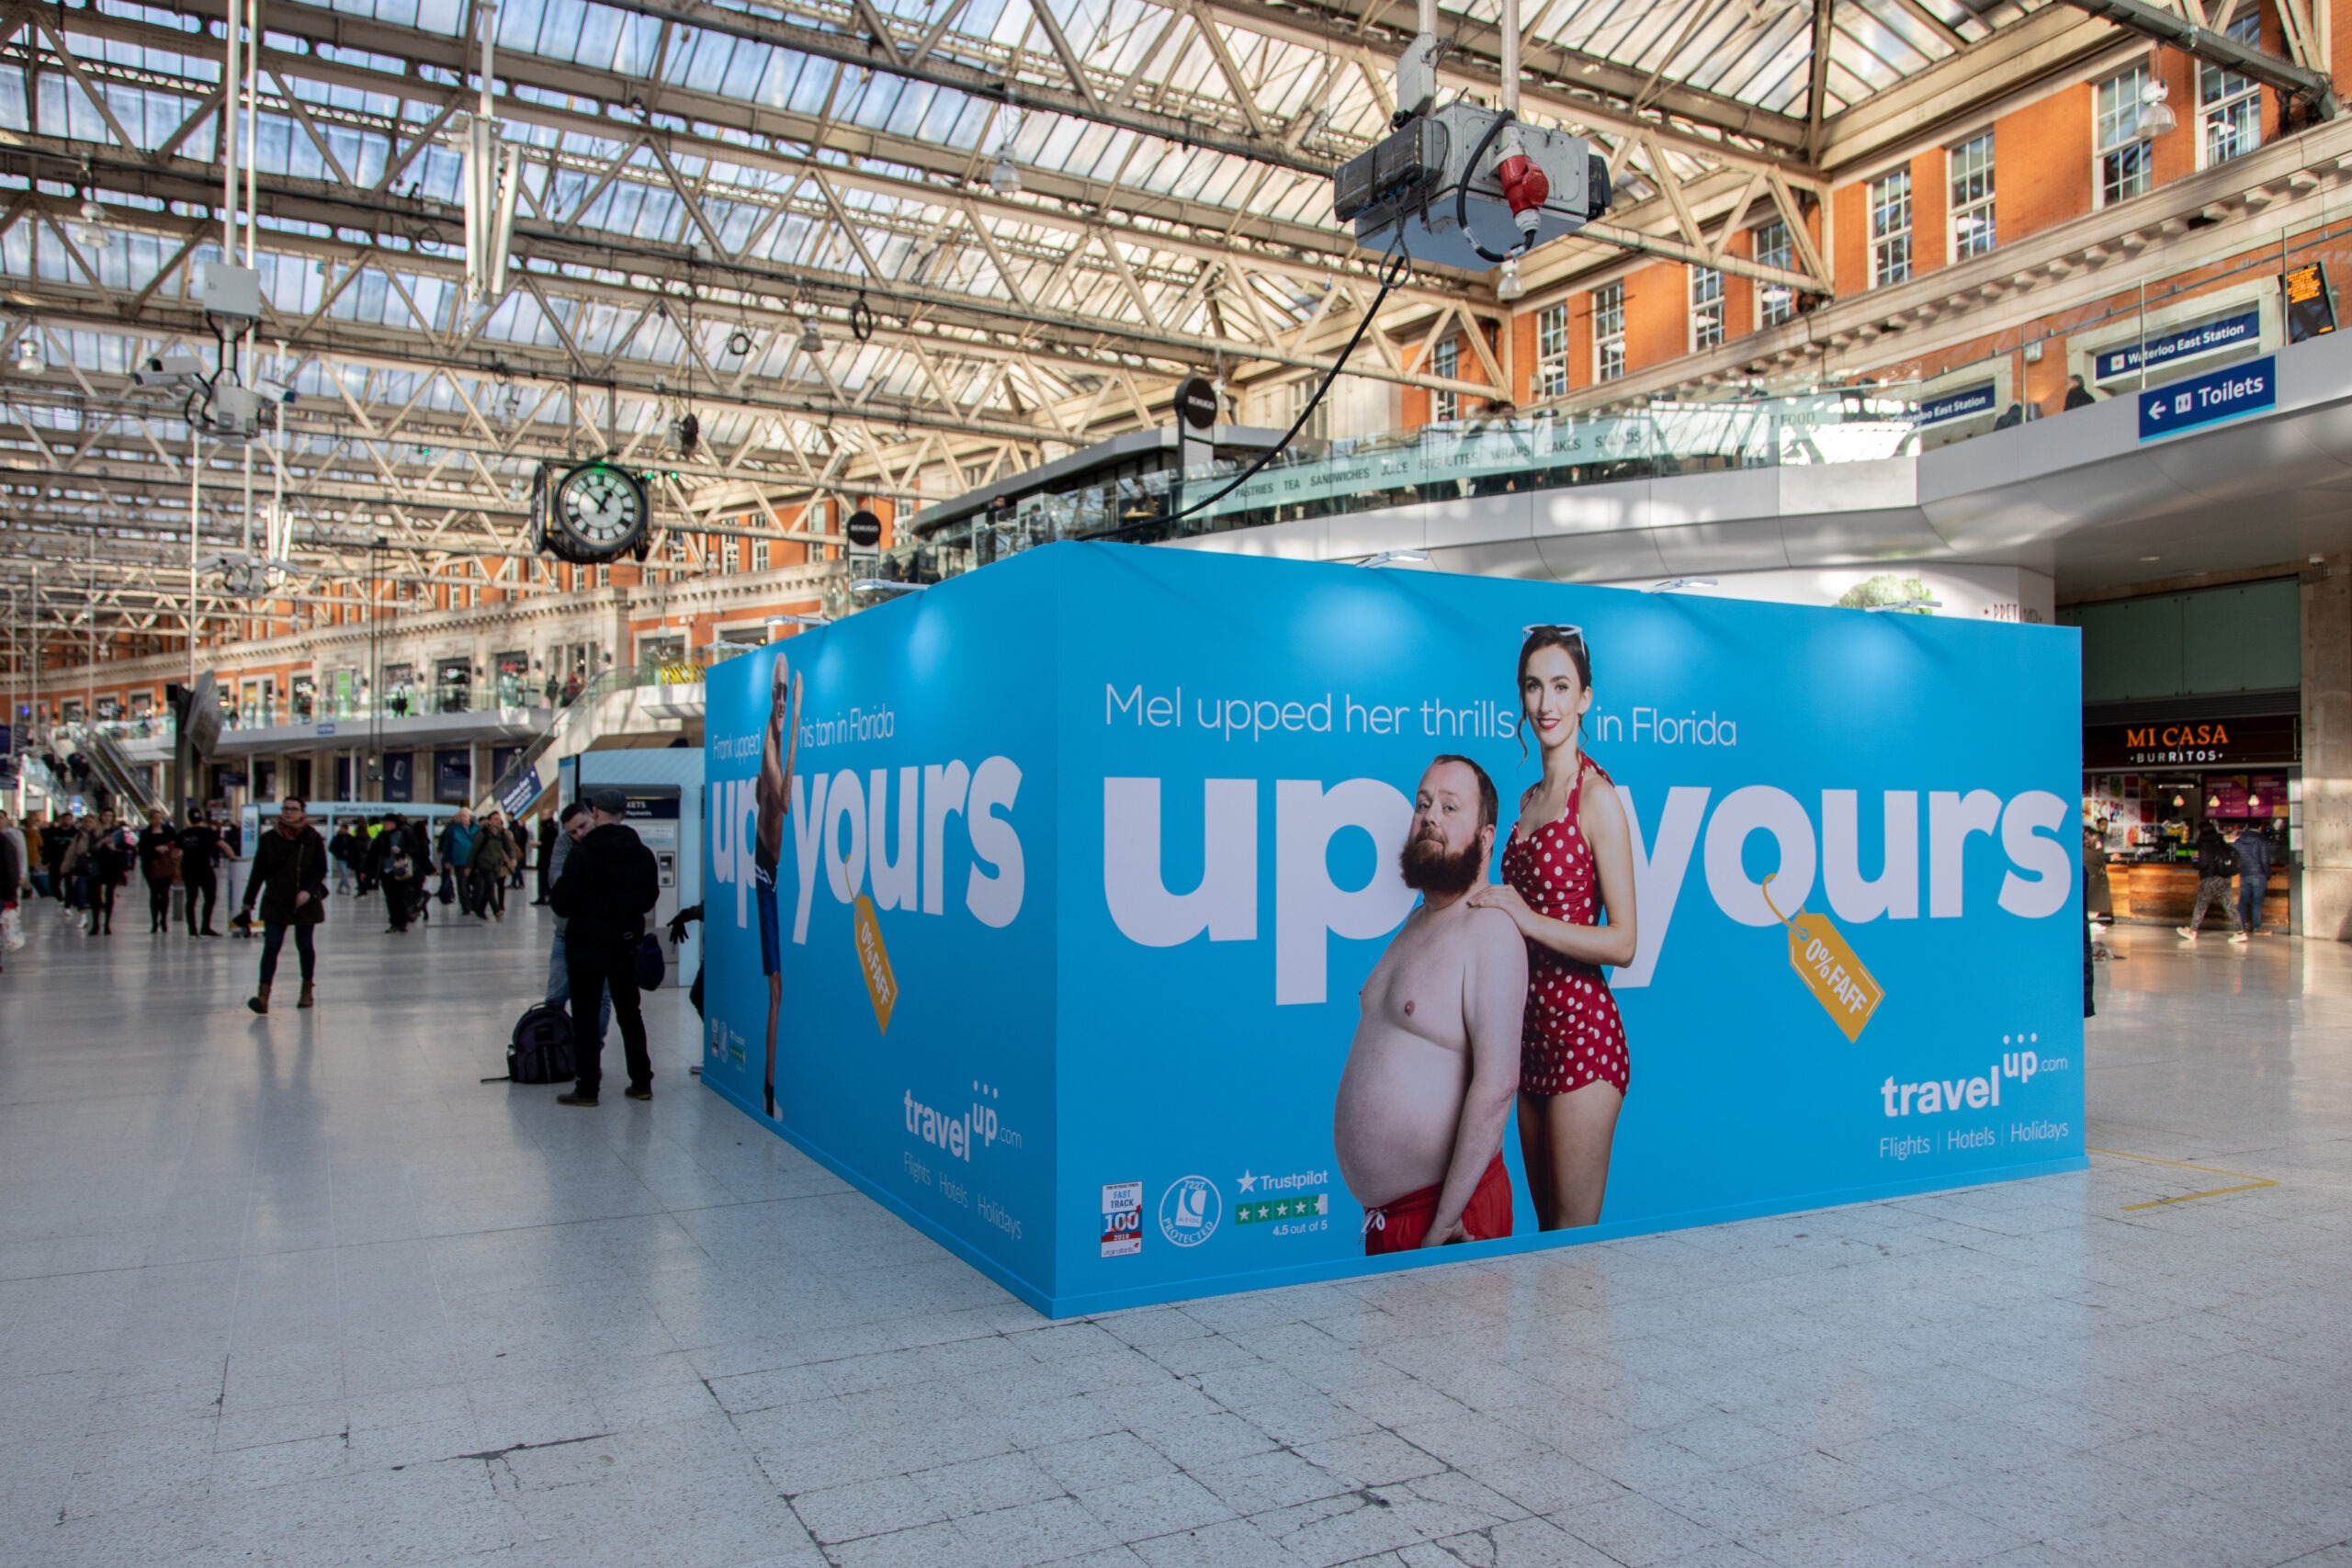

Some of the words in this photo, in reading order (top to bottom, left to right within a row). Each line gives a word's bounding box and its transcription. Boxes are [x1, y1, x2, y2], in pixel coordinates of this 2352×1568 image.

[2177, 334, 2201, 352] East
[2203, 323, 2245, 344] Station
[2199, 377, 2264, 408] Toilets
[1781, 412, 1815, 425] FOOD
[1934, 404, 1952, 417] East
[1953, 396, 1985, 412] Station
[1283, 478, 1300, 491] TEA
[1310, 467, 1370, 488] SANDWICHES
[1381, 461, 1408, 477] JUICE
[1106, 682, 1181, 727] Mel
[1198, 693, 1331, 742] upped
[1346, 694, 1410, 734] her
[1419, 698, 1515, 738] thrills
[1597, 705, 1623, 742] in
[1633, 706, 1736, 746] Florida
[713, 735, 733, 761] Frank
[734, 728, 761, 764] upped
[799, 716, 813, 749] his
[816, 718, 835, 748] tan
[837, 712, 847, 744] in
[850, 704, 895, 741] Florida
[2126, 728, 2156, 748] MI
[2162, 724, 2229, 747] CASA
[2136, 750, 2217, 763] BURRITOS
[712, 776, 757, 929] up
[791, 755, 1025, 945] yours
[1104, 776, 1421, 1006] up
[1610, 784, 2072, 990] yours
[1881, 1134, 1930, 1161] Flights
[1948, 1127, 1996, 1150] Hotels
[2011, 1120, 2068, 1143] Holidays
[1184, 1180, 1205, 1190] 7227
[1261, 1169, 1328, 1190] Trustpilot
[904, 1151, 931, 1185] Flights
[940, 1172, 968, 1208] Hotels
[978, 1194, 1022, 1240] Holidays
[1111, 1199, 1134, 1209] TRACK
[1114, 1190, 1131, 1200] FAST
[1104, 1211, 1139, 1233] 100
[1163, 1217, 1213, 1243] PROTECTED
[1272, 1225, 1289, 1236] 4.5
[1290, 1224, 1306, 1234] out
[1308, 1221, 1318, 1232] of
[1321, 1220, 1328, 1230] 5
